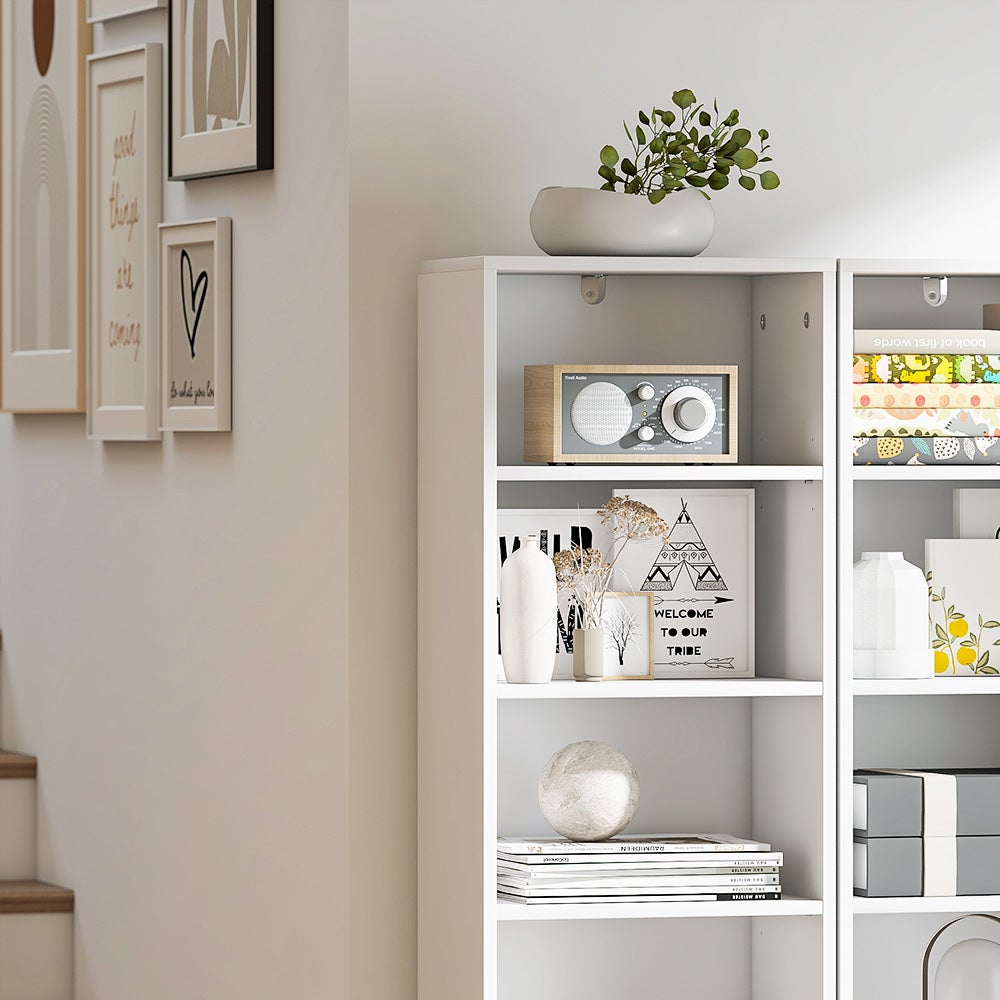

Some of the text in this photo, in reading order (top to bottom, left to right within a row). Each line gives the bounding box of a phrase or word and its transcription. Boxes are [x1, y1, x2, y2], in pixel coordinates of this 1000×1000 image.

[112, 110, 136, 176] good
[109, 181, 139, 241] things
[116, 259, 134, 290] are
[109, 313, 141, 362] coming
[874, 338, 986, 349] book of first words
[654, 609, 714, 618] WELCOME
[660, 627, 708, 637] TO OUR
[666, 646, 702, 656] TRIBE
